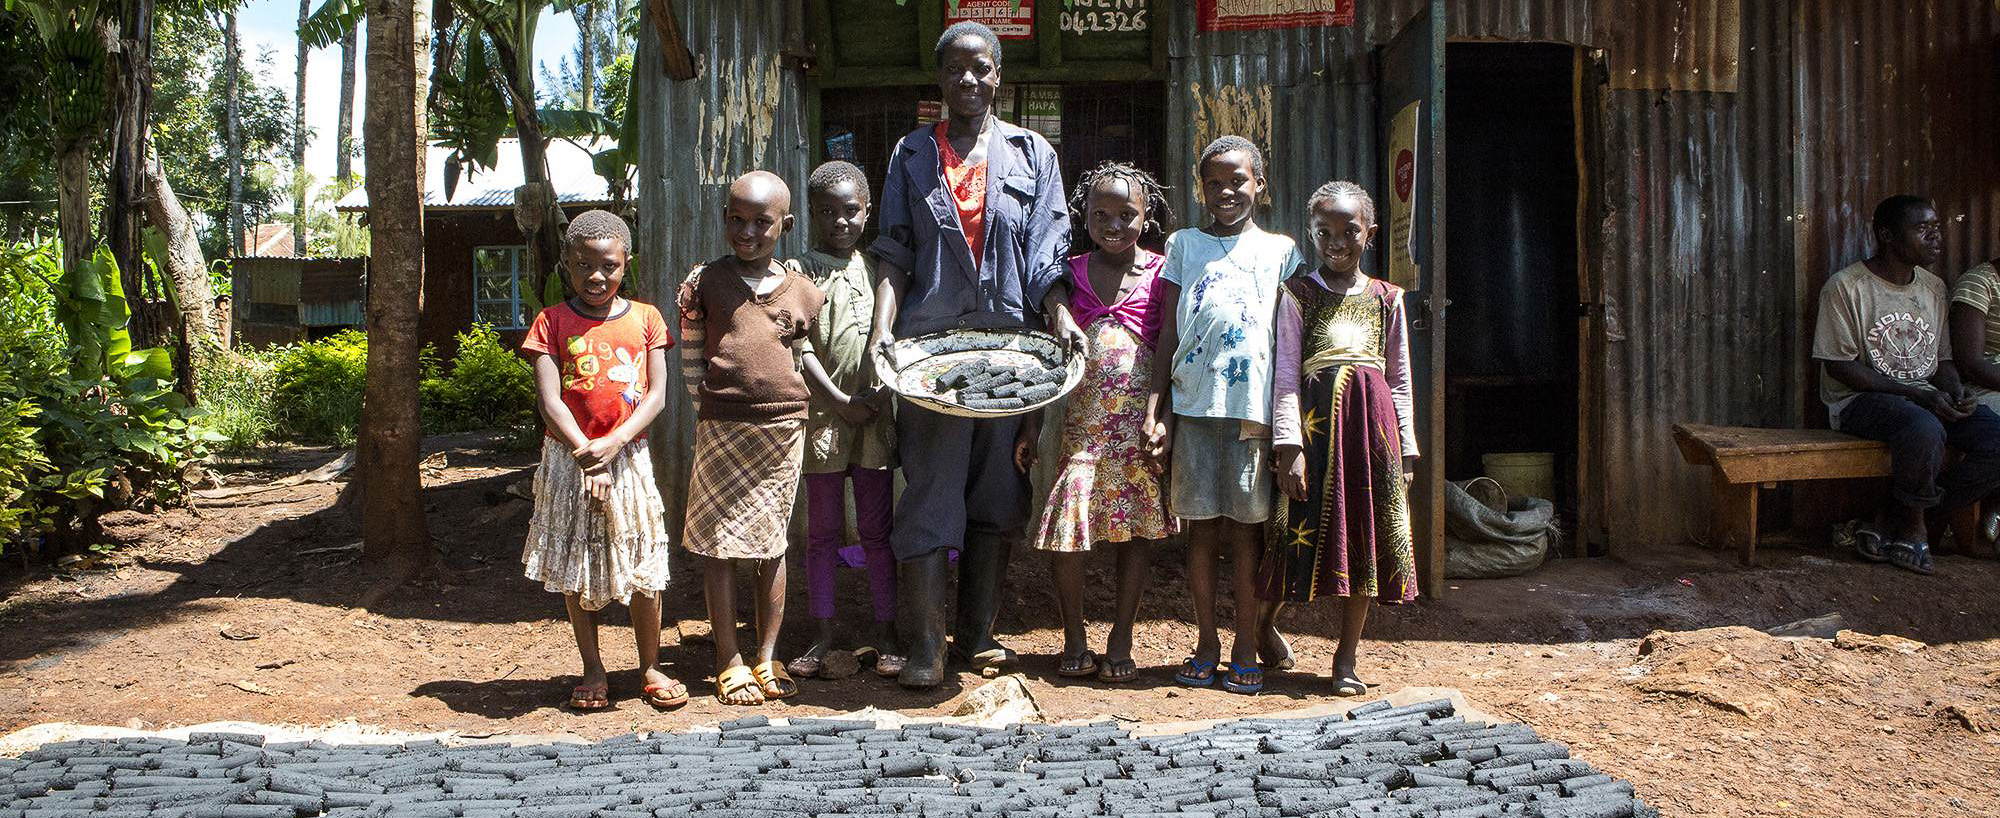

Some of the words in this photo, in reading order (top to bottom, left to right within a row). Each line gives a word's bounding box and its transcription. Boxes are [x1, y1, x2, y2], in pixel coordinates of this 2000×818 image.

[1060, 9, 1147, 36] 042326
[1028, 102, 1057, 111] HAPA
[1867, 312, 1936, 345] INDIANA
[1869, 348, 1936, 379] BASKETBALL
